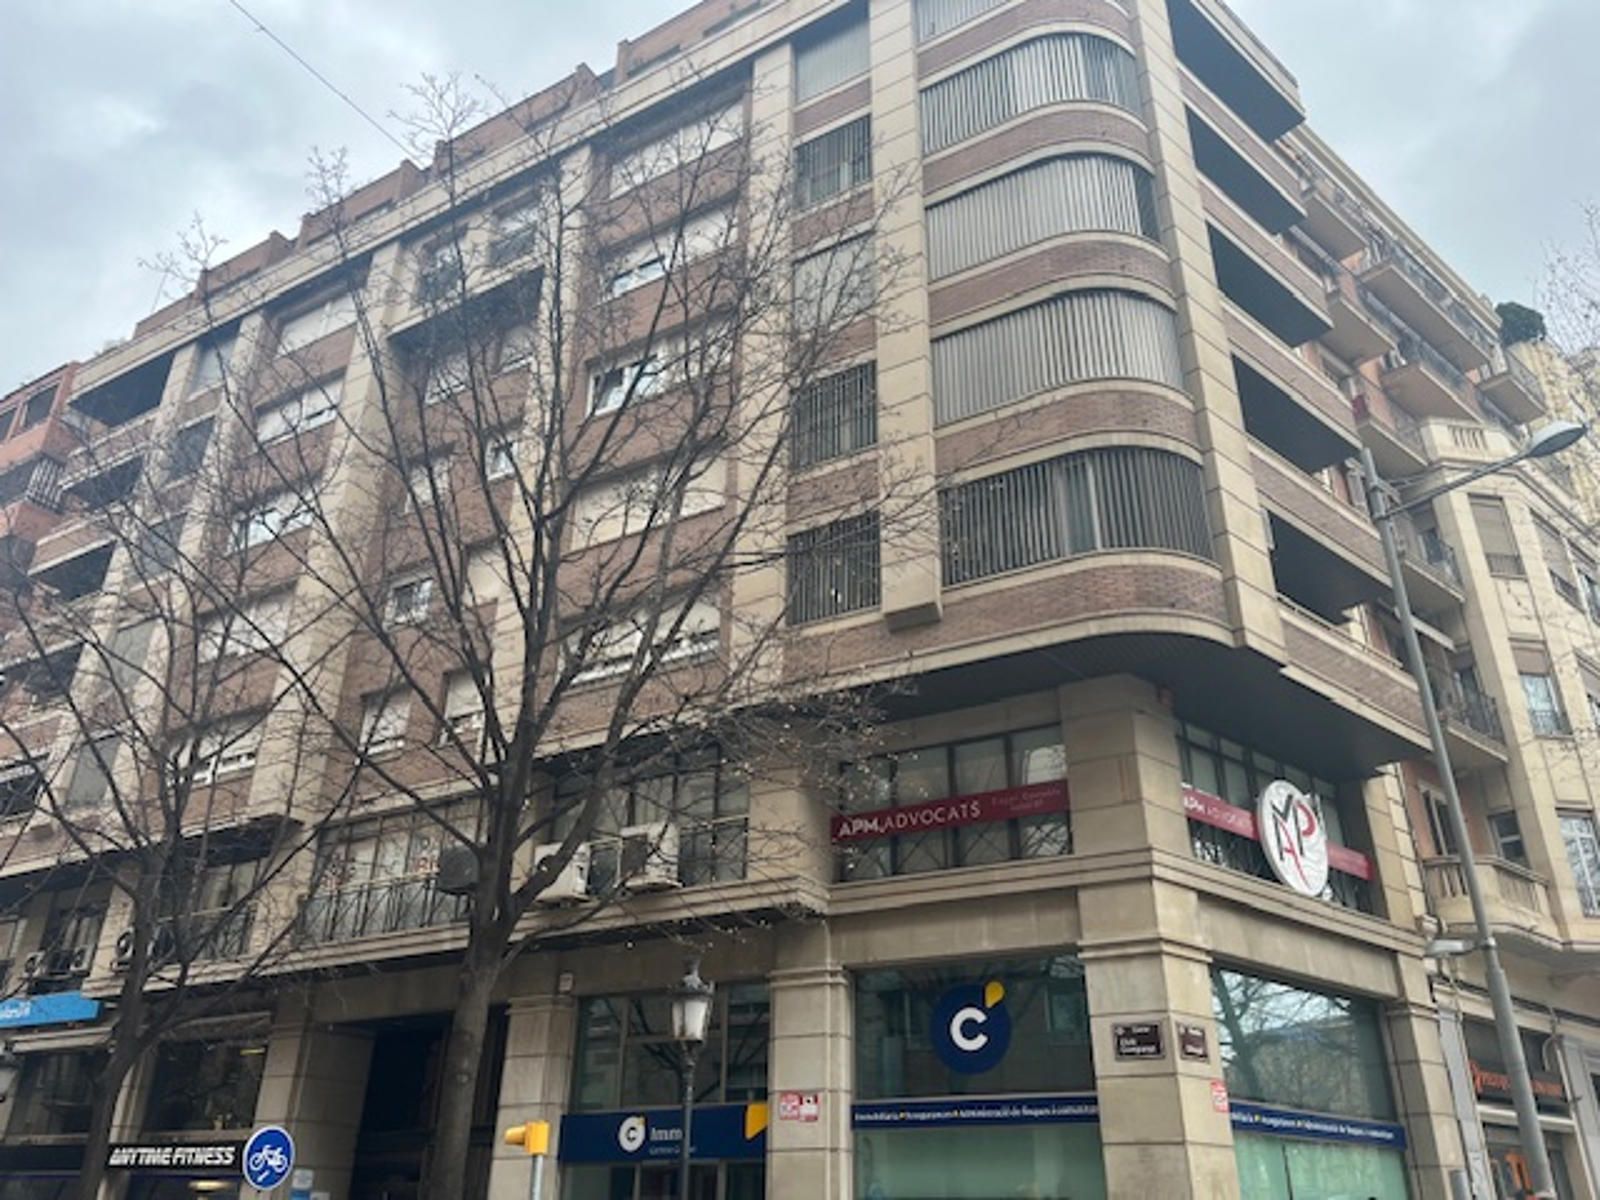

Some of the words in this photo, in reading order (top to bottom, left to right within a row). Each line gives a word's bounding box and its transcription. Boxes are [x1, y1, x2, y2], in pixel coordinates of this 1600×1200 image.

[839, 816, 880, 837] APM
[881, 801, 981, 831] ADVOCATS
[109, 1147, 173, 1166] ANYTIME
[173, 1146, 236, 1166] FITNESS
